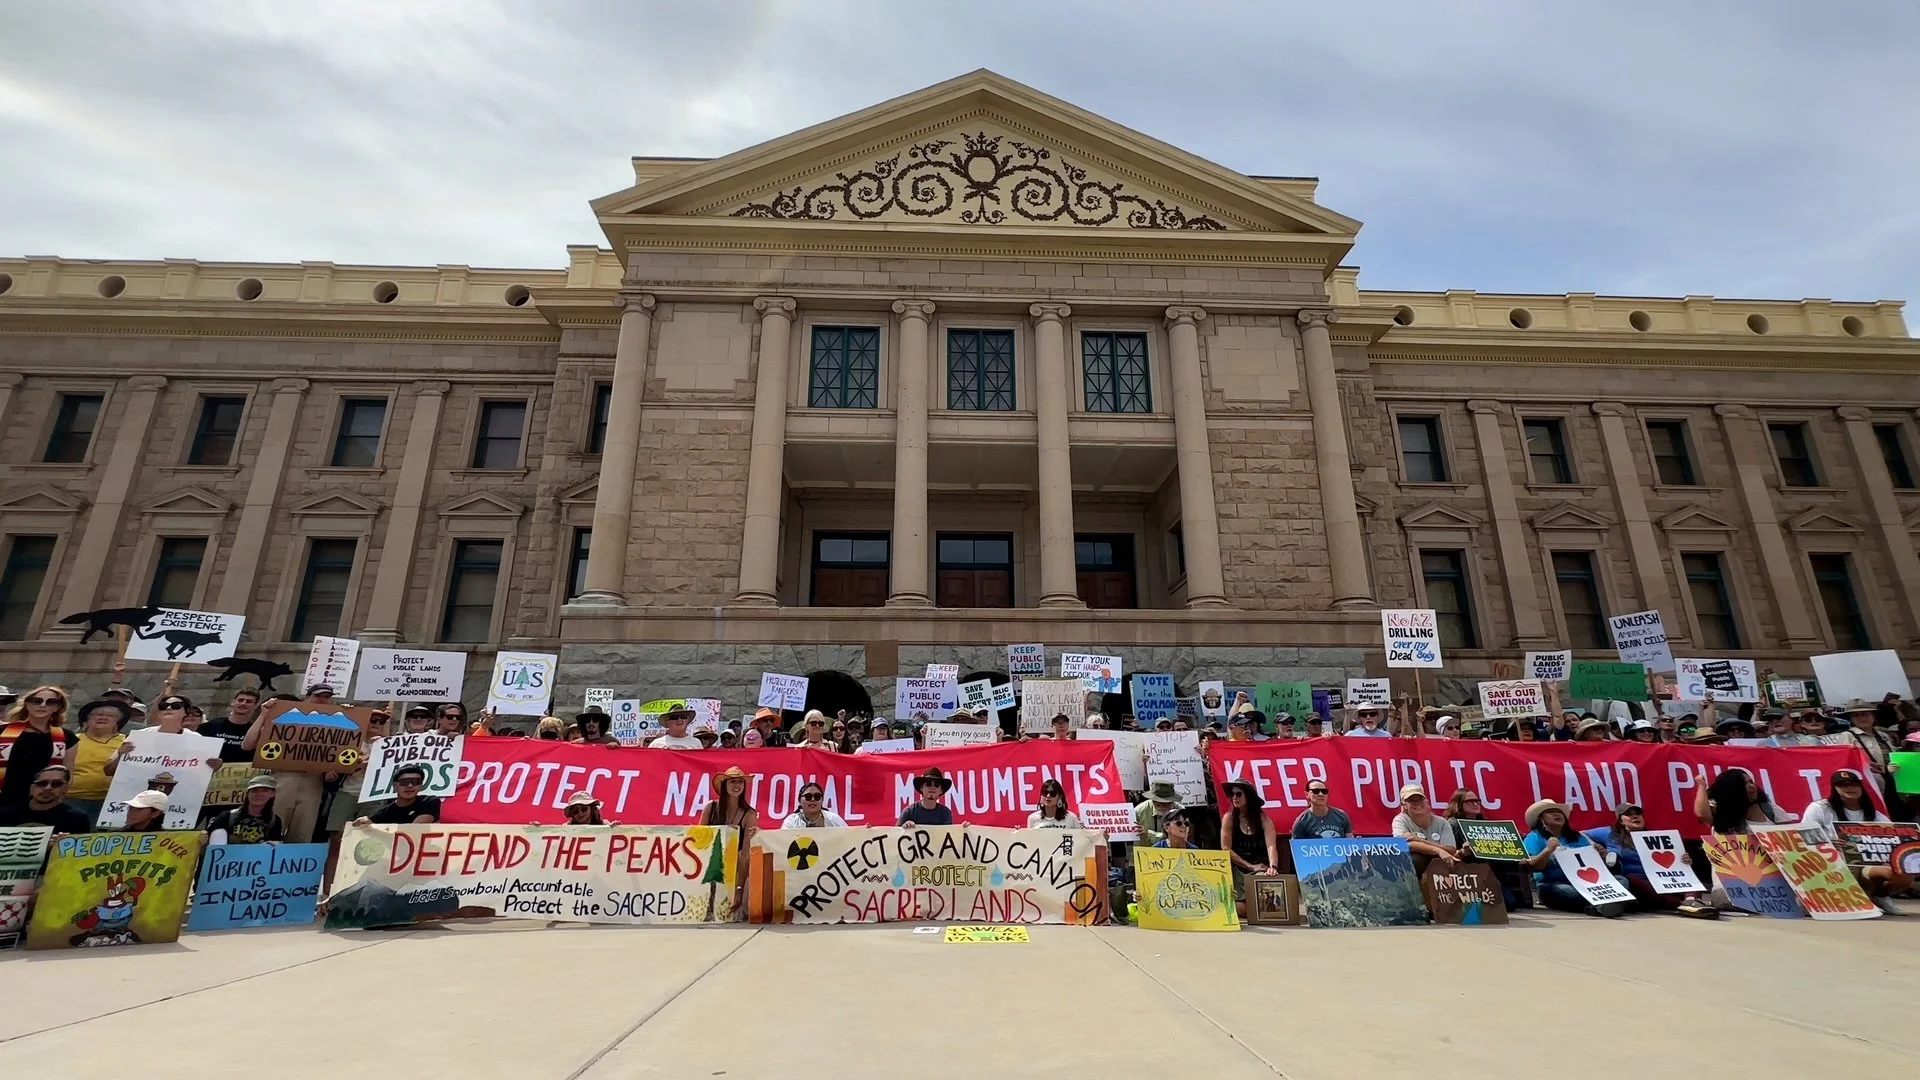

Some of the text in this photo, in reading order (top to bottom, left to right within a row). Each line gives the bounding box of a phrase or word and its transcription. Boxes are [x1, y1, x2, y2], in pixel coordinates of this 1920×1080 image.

[165, 611, 222, 623] RESPECT
[1613, 613, 1660, 629] UNLEASH
[160, 619, 227, 632] EXISTENCE
[1388, 628, 1434, 639] DRILLING
[1393, 641, 1429, 651] over my
[1618, 634, 1667, 650] BRAIN CELLS
[1013, 646, 1036, 654] KEEP
[393, 653, 425, 664] PROTECT
[1010, 655, 1042, 663] PUBLIC
[1065, 655, 1110, 665] KEEP YOUR
[1389, 650, 1435, 662] Dead Body
[1535, 654, 1565, 662] PUBLIC
[1014, 662, 1041, 670] LAND
[1533, 660, 1560, 668] LANDS
[1494, 662, 1510, 678] NO
[927, 672, 956, 680] PUBLIC
[1141, 676, 1169, 686] VOTE
[907, 680, 946, 688] PROTECT
[965, 684, 983, 693] SAVE
[909, 692, 941, 700] PUBLIC
[968, 692, 983, 701] OUR
[1025, 693, 1083, 705] PUBLIC LANDS
[1143, 689, 1172, 698] for the
[1487, 688, 1536, 699] SAVE OUR
[910, 702, 939, 710] LANDS
[1136, 699, 1176, 709] COMMON
[1489, 697, 1538, 707] NATIONAL
[1138, 710, 1167, 720] GOOD
[1497, 706, 1534, 715] LANDS
[615, 713, 636, 721] OUR
[614, 721, 635, 730] LAND
[269, 724, 362, 747] NO URANIUM
[614, 729, 637, 737] WATER
[952, 730, 972, 739] enjoy
[973, 731, 991, 739] going
[1155, 732, 1187, 742] STOP
[381, 735, 454, 749] SAVE OUR
[283, 742, 337, 763] MINING
[381, 747, 452, 768] PUBLIC
[161, 755, 199, 767] PROFITS
[369, 762, 455, 797] LDS
[457, 761, 1110, 822] PROTECT NAIONAL MNUMETS
[1350, 757, 1502, 811] PUBLIC
[1528, 760, 1643, 813] LAND
[1667, 761, 1863, 820] PLI
[1102, 809, 1129, 817] PUBLIC
[1486, 826, 1510, 834] RURAL
[1466, 832, 1518, 841] COMMUNITIES
[1756, 830, 1809, 852] SAVE
[1860, 834, 1901, 845] Need
[57, 835, 188, 860] PEOPLE OVER
[1474, 840, 1516, 849] DEPEND ON
[1642, 835, 1675, 851] WE
[388, 831, 703, 880] DEFEND THE PEAKS
[1300, 843, 1401, 858] SAVE OUR PARKS
[1474, 846, 1524, 856] PUBLIC LANDS
[207, 847, 318, 883] PUBLIC LAND
[1574, 853, 1586, 868] I
[788, 829, 1109, 928] PROTECT GRAND CANYON
[911, 864, 987, 888] PROTECT
[1824, 871, 1845, 885] AND
[250, 876, 267, 890] IS
[1166, 873, 1206, 896] OUR
[1587, 883, 1613, 893] PUBLIC
[1662, 882, 1693, 890] RIVERS
[199, 884, 320, 905] INDIGENOUS
[408, 876, 594, 904] Hold Snowbowl Accountable
[1593, 888, 1617, 897] LANDS
[1726, 885, 1788, 899] OUR PUBLIC
[1438, 890, 1491, 905] the WILD
[1598, 892, 1627, 901] WATERS
[1803, 885, 1875, 913] WATERS
[504, 890, 686, 918] Protect the SACRED
[843, 887, 946, 923] SACRED
[229, 902, 288, 921] LAND
